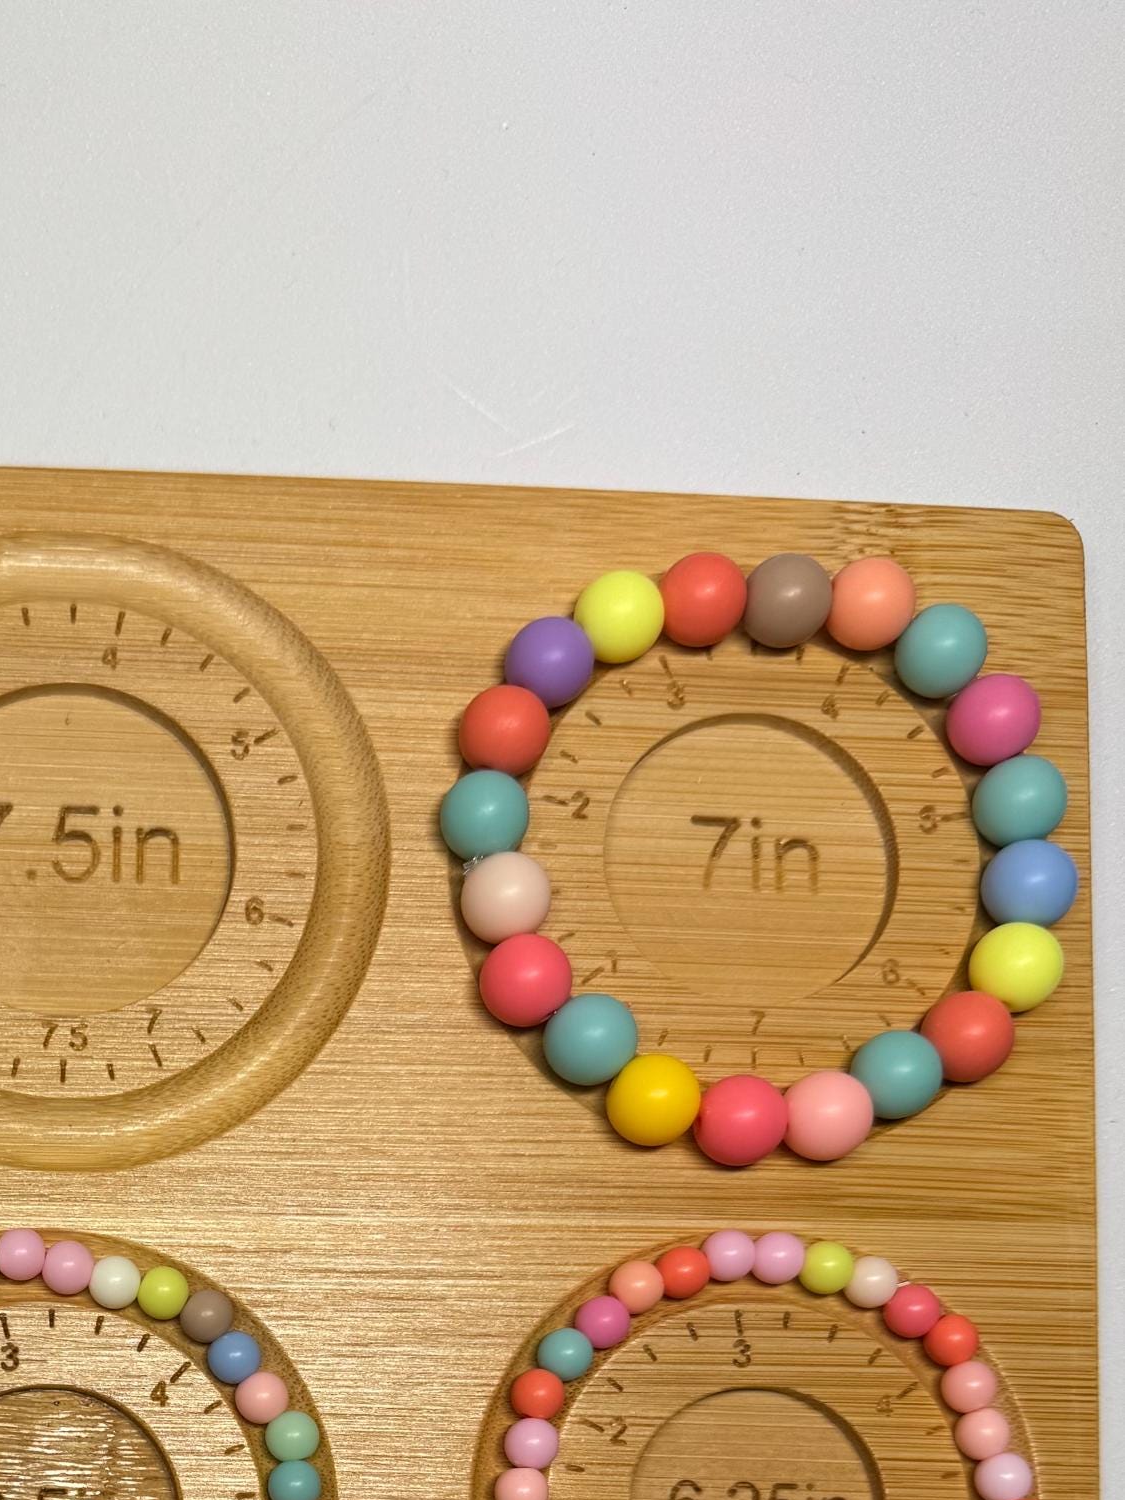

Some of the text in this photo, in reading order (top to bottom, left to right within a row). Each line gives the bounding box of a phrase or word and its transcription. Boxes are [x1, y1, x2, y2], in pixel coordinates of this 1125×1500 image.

[102, 647, 118, 671] 4
[667, 681, 686, 710] 3
[820, 695, 839, 720] 4
[230, 730, 251, 760] 5
[571, 791, 591, 819] 2
[689, 815, 821, 894] 7in
[244, 897, 266, 926] 6
[881, 959, 901, 984] 6
[146, 1007, 163, 1035] 7
[750, 1010, 766, 1036] 7
[1, 1342, 20, 1372] 3
[732, 1339, 752, 1368] 3
[150, 1380, 169, 1407] 4
[877, 1395, 894, 1416] 4
[611, 1416, 628, 1445] 2
